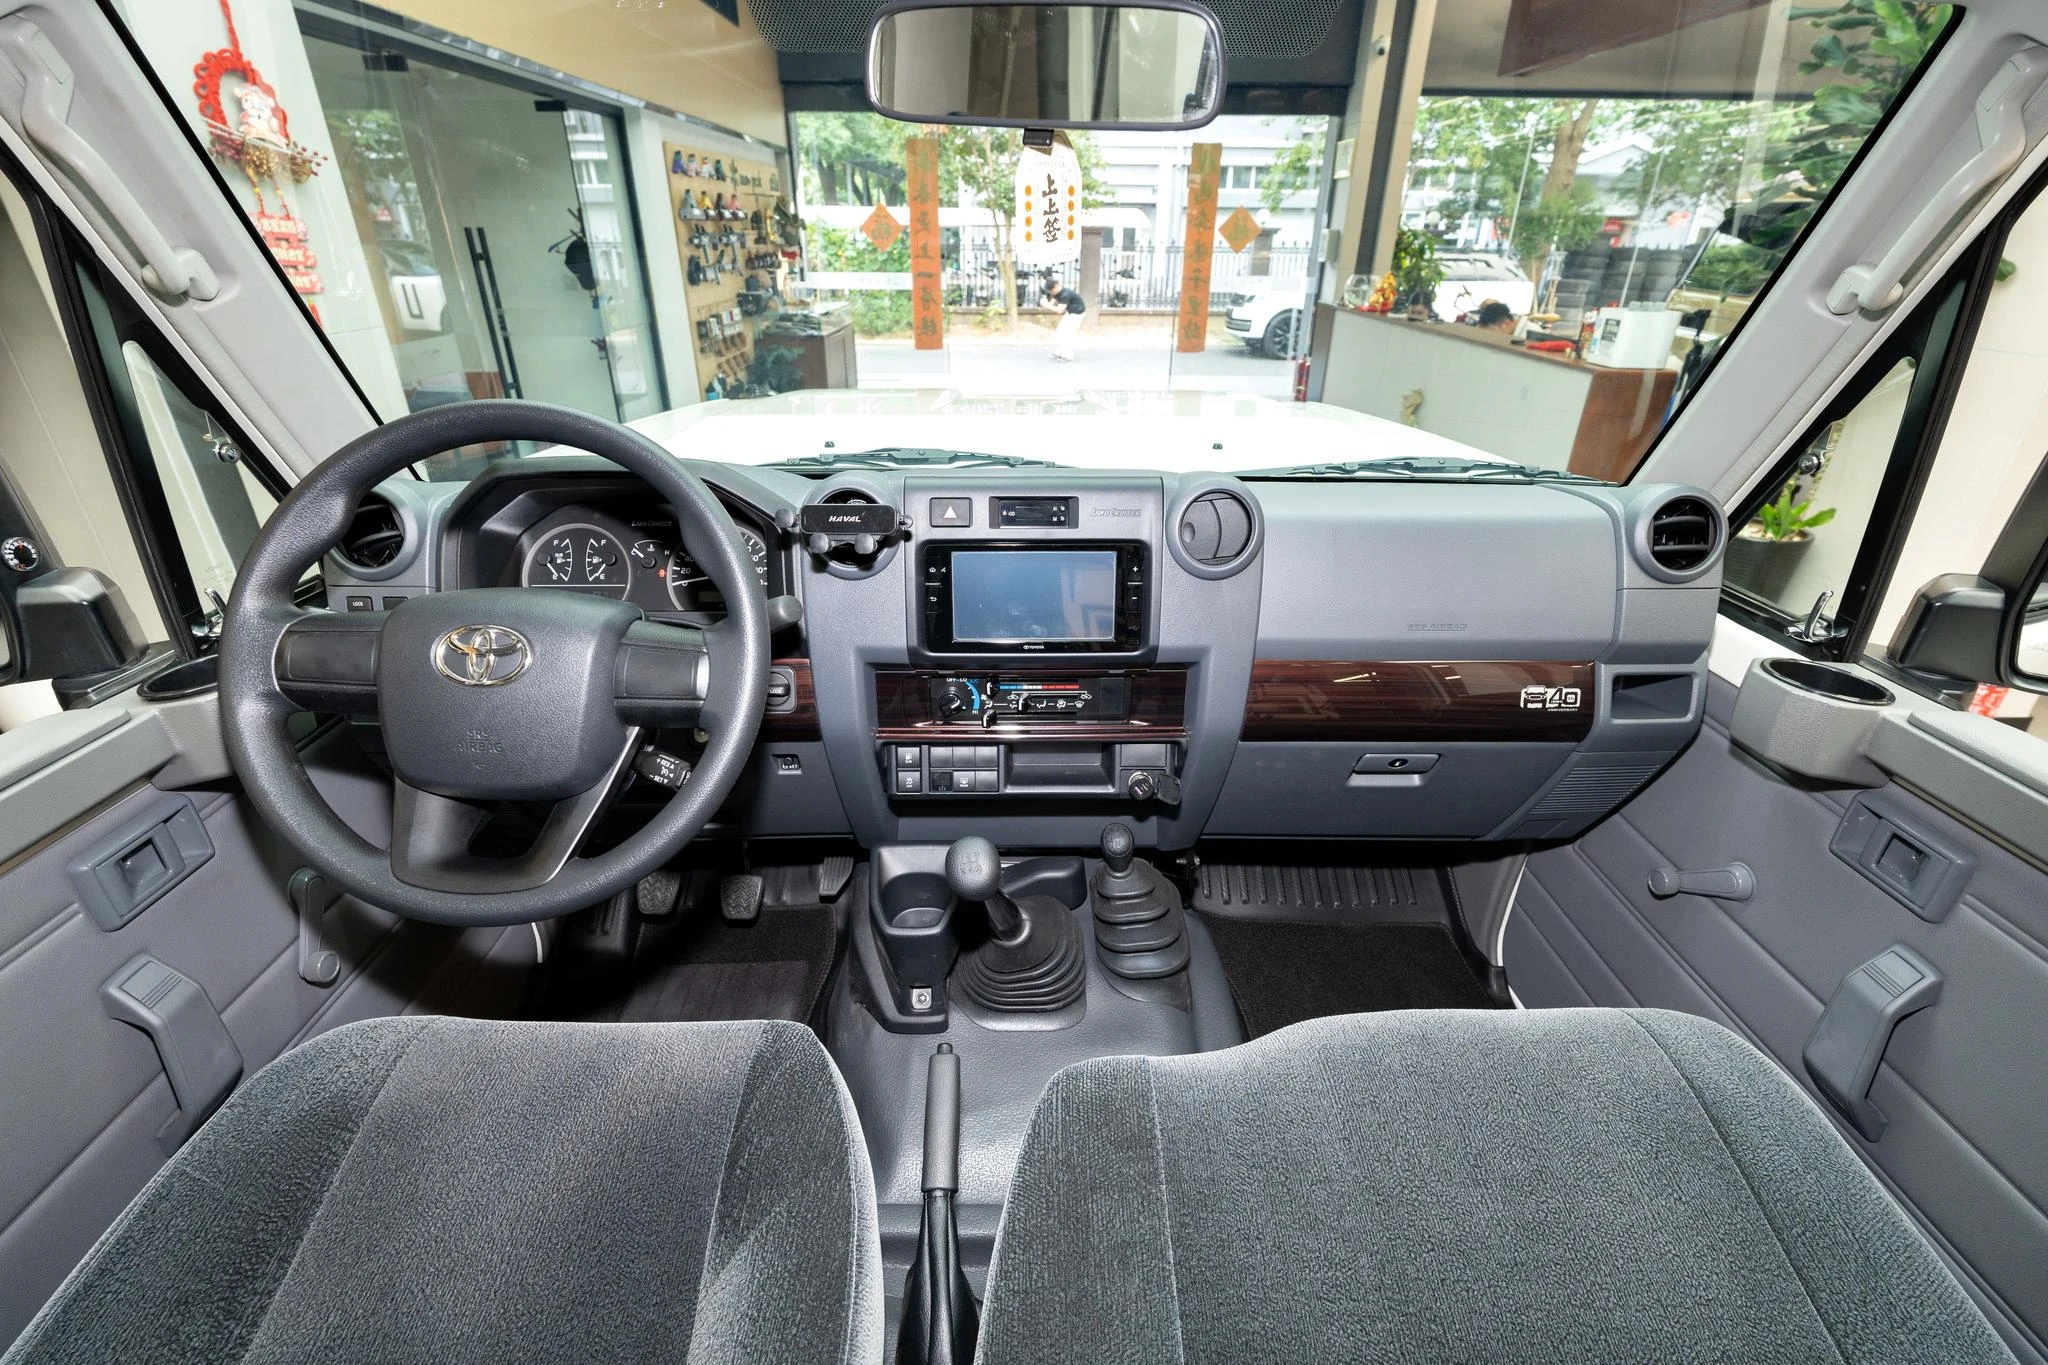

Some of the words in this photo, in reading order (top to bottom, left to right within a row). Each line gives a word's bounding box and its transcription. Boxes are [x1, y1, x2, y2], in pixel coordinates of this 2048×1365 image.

[1042, 173, 1060, 243] 上上签
[828, 515, 861, 523] HAVAL
[769, 686, 784, 694] LOCK
[1548, 687, 1579, 706] 40
[465, 728, 488, 740] SRS
[457, 741, 503, 753] AIRBAG
[653, 775, 664, 783] SET
